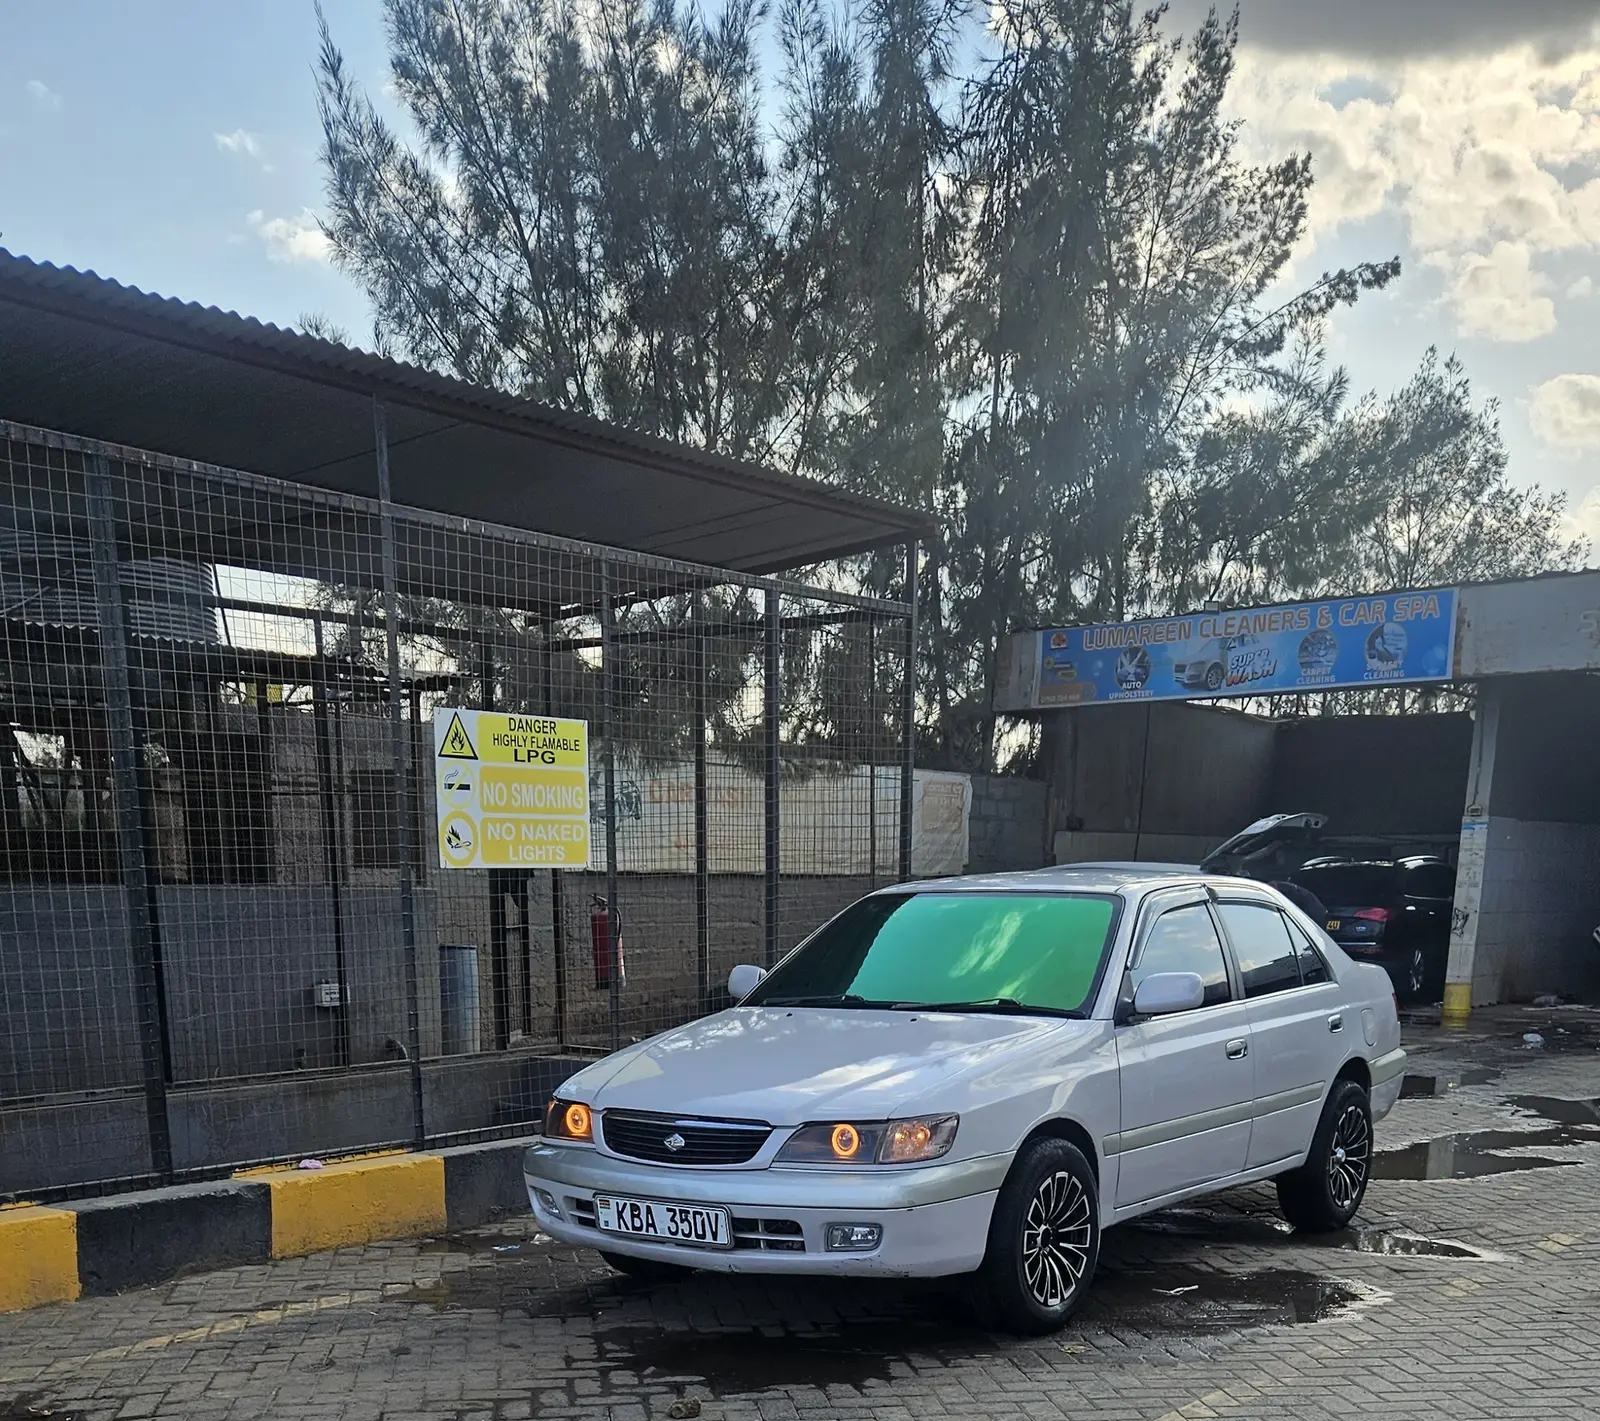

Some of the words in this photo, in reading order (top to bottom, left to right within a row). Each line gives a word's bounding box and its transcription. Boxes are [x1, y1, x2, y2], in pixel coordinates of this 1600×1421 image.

[1083, 619, 1192, 651] LUMAREEN
[1200, 607, 1310, 639] CLEANERS
[1316, 606, 1333, 629] &
[1339, 599, 1387, 627] CAR
[1394, 595, 1440, 622] SPA
[1231, 648, 1270, 669] SUPER
[1226, 658, 1278, 688] WASH
[1296, 675, 1336, 685] CLEANING
[1302, 667, 1332, 676] CARPET
[1364, 670, 1405, 680] CLEANING
[1122, 681, 1142, 690] AUTO
[1108, 690, 1155, 700] UPHOLSTERY
[508, 717, 557, 735] DANGER
[492, 733, 528, 748] HIGHLY
[530, 736, 580, 752] FLAMABLE
[513, 749, 556, 764] LPG
[483, 781, 507, 807] NO
[511, 783, 584, 809] SMOKING
[487, 822, 516, 841] NO
[521, 823, 585, 842] NAKED
[508, 844, 566, 861] LIGHTS
[615, 1201, 658, 1235] KBA
[665, 1207, 719, 1242] 350V
